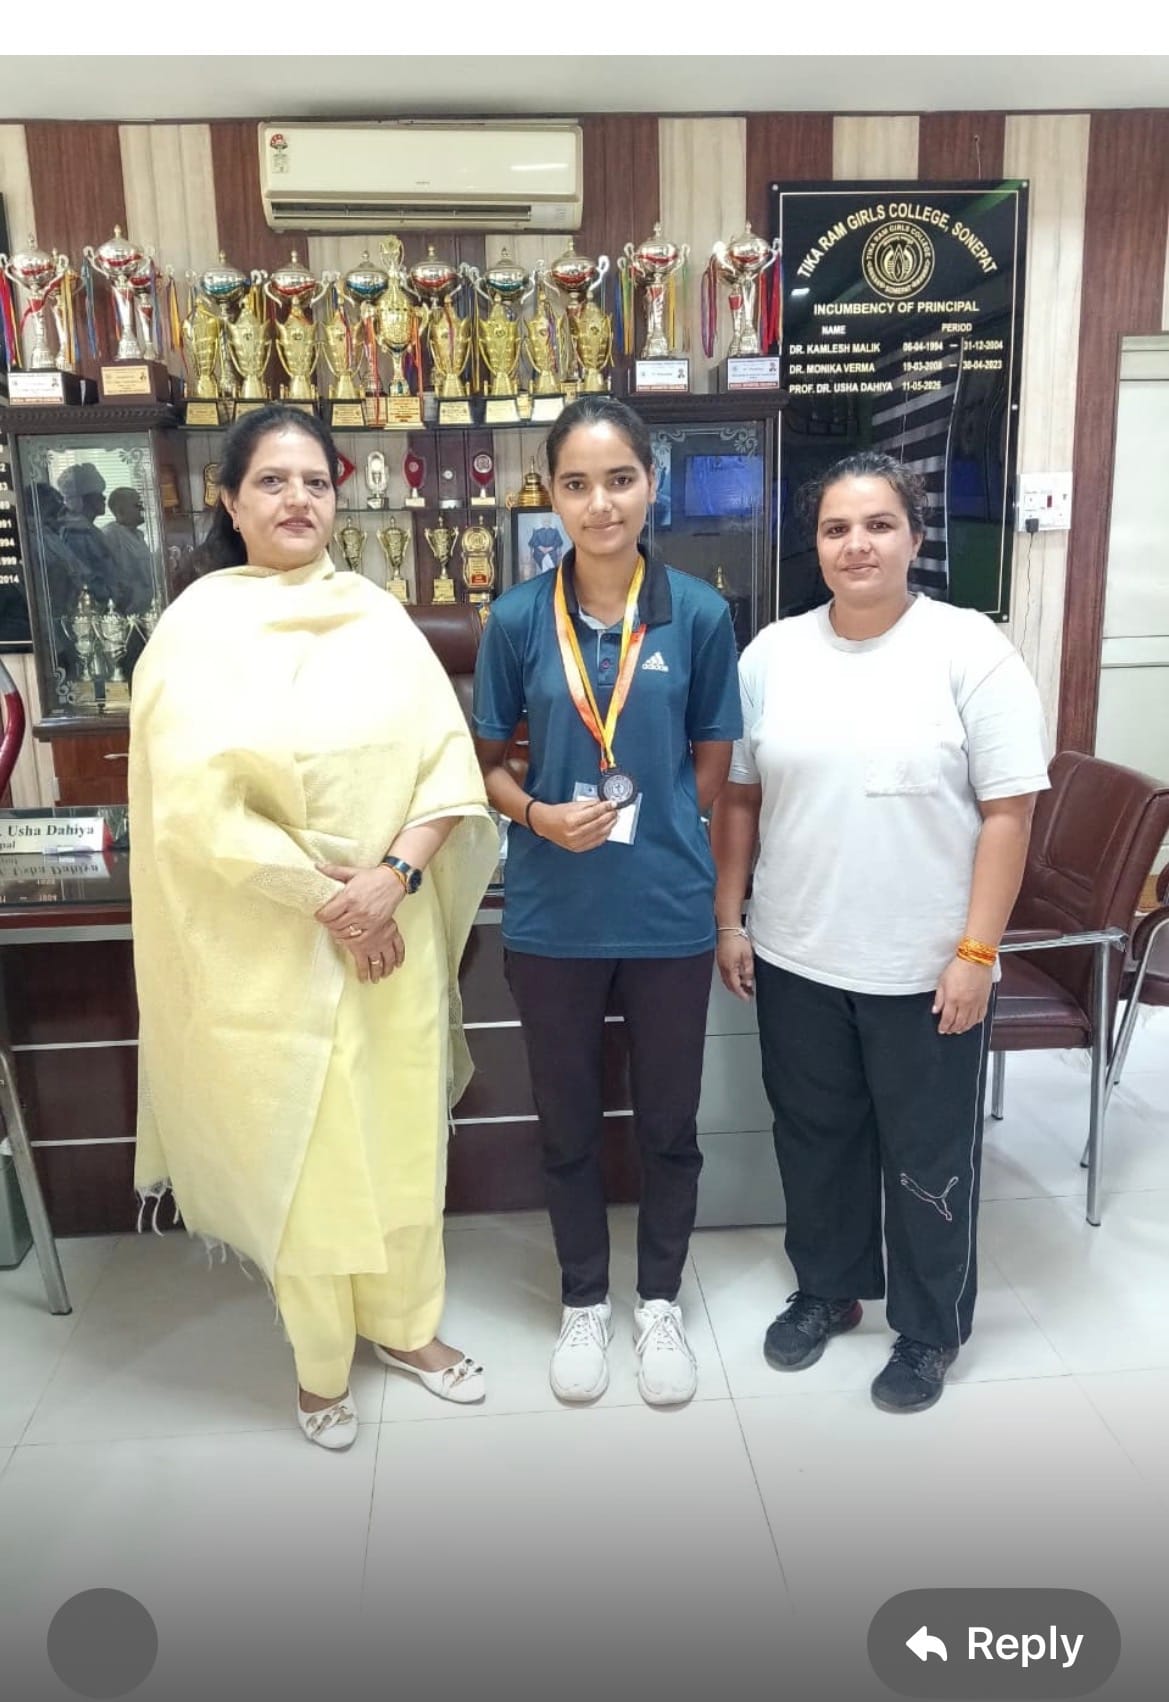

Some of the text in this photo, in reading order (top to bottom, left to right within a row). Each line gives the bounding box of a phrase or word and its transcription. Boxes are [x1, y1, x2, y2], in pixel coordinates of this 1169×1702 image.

[797, 203, 998, 278] TIKA RAM GIRLS COLLEGE, SONEPAT
[813, 300, 980, 316] INCUMBENCY OF PRINCIPAL
[821, 325, 847, 335] NAME
[941, 323, 973, 333] PERIOD
[789, 342, 881, 355] DR. KAMLESH MALIK
[789, 362, 876, 375] DR. MONIKA VERMA
[789, 381, 894, 394] PROF. DR. USHA DAHIYA
[8, 824, 94, 838] Usha Dahiya
